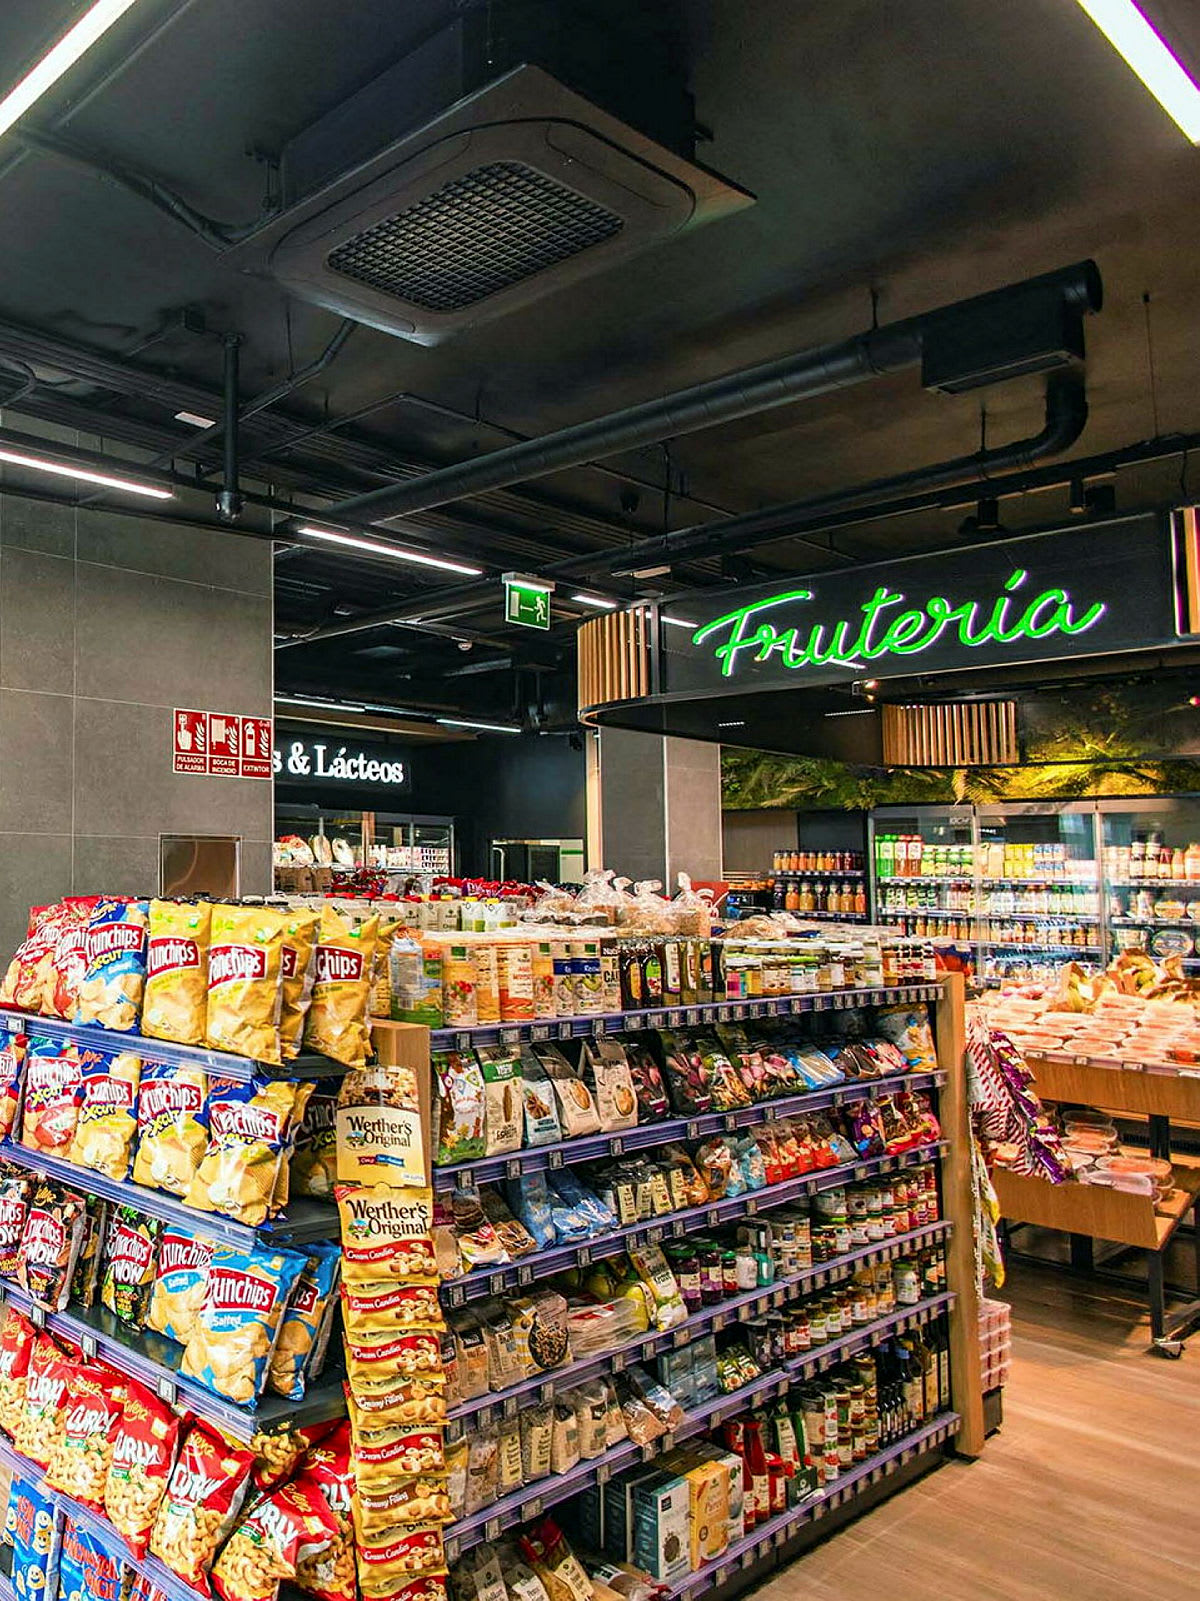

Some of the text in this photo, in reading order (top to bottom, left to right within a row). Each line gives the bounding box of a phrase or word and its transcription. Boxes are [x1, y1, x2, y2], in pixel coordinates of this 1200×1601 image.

[692, 570, 1105, 677] Frutería
[176, 756, 205, 764] PULSADOR
[243, 765, 270, 773] EXTINTOR
[287, 742, 312, 775] &
[314, 745, 404, 783] Lácteos
[148, 940, 195, 970] runchips
[317, 949, 358, 979] chips
[346, 1116, 412, 1135] Werther's
[364, 1131, 411, 1148] Original
[345, 1199, 428, 1221] Werther's
[368, 1214, 427, 1238] Original
[160, 1241, 213, 1272] runchips
[347, 1247, 395, 1261] Cream Candies
[352, 1296, 400, 1309] Cream Candies
[212, 1314, 242, 1327] Salted
[354, 1345, 401, 1359] Cream Candies
[66, 1404, 118, 1434] CURLY
[112, 1430, 161, 1466] URLY
[250, 1500, 298, 1547] URLY
